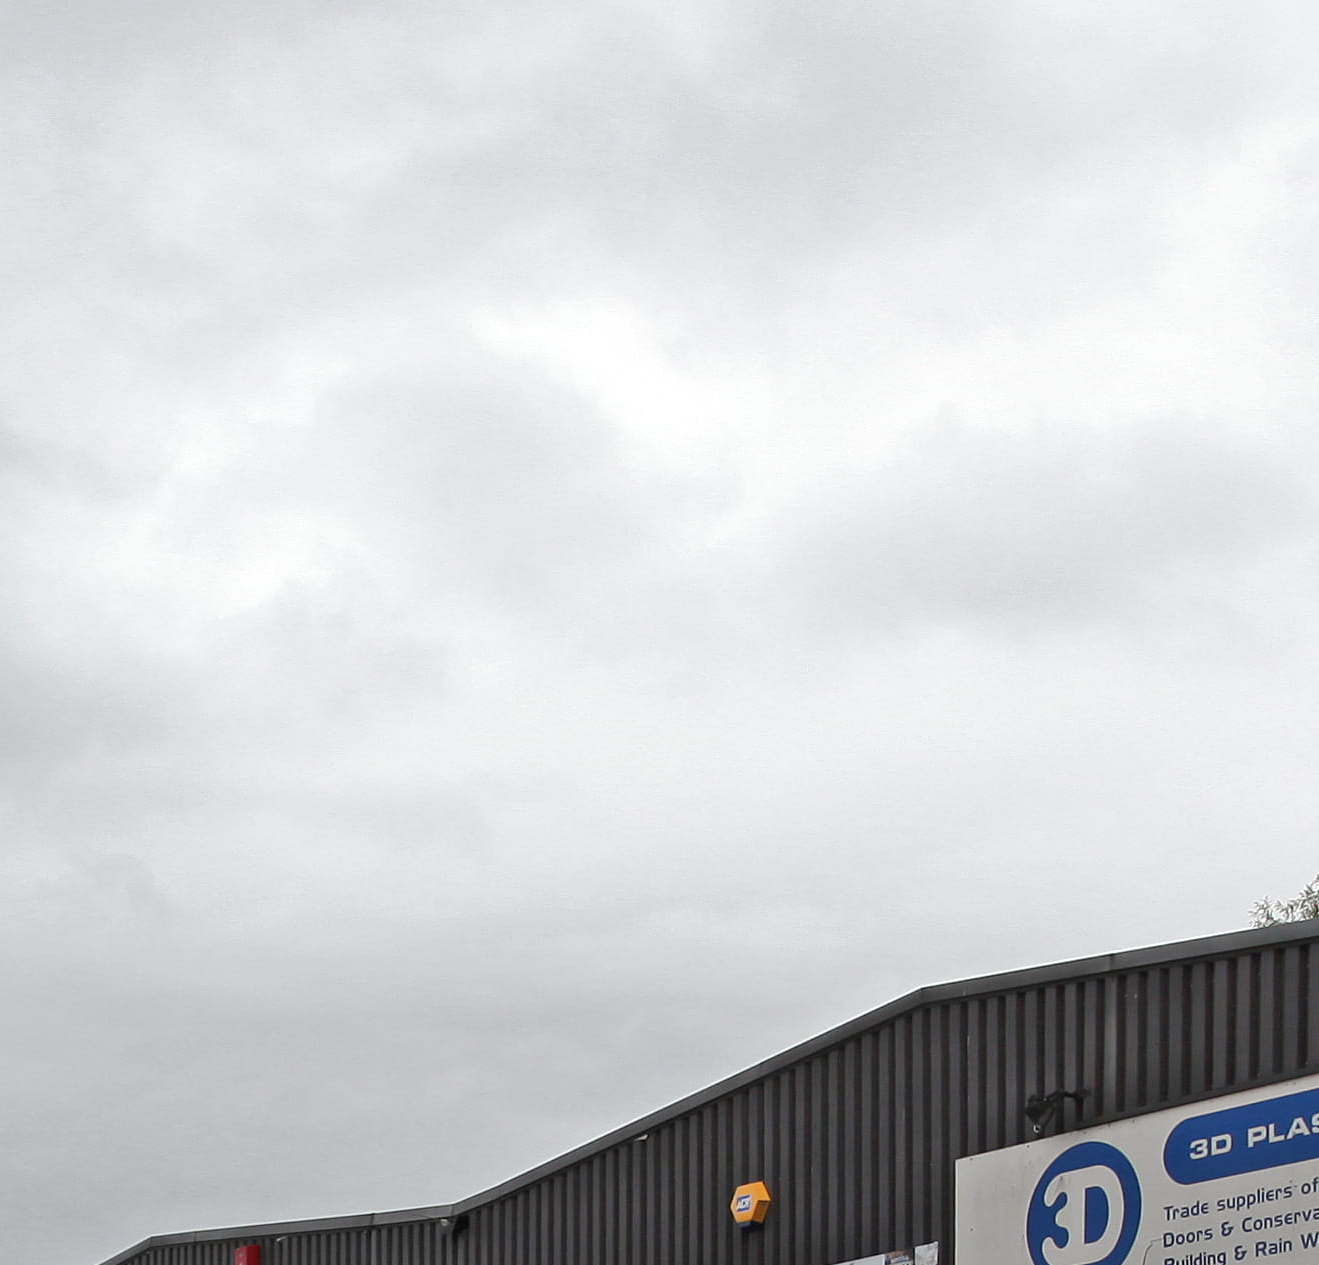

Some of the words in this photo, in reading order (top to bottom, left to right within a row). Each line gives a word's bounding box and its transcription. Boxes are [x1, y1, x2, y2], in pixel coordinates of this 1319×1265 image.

[1189, 1132, 1232, 1160] 3D
[1164, 1201, 1209, 1222] Trade
[1217, 1184, 1293, 1212] suppliers
[1301, 1177, 1319, 1195] of
[1163, 1228, 1213, 1248] Doors
[1221, 1222, 1234, 1237] &
[1234, 1245, 1248, 1261] &
[1255, 1238, 1292, 1258] Rain
